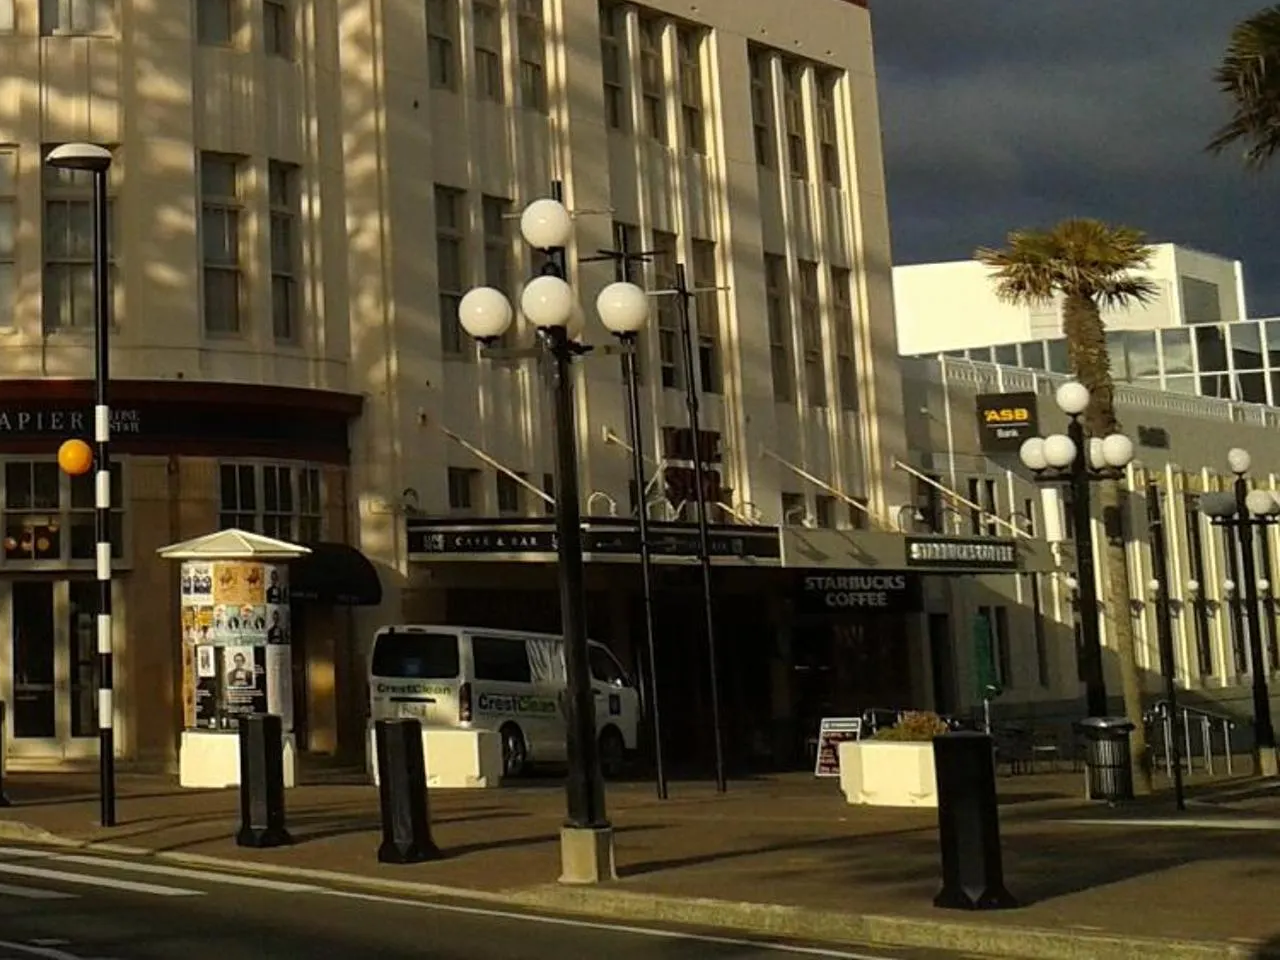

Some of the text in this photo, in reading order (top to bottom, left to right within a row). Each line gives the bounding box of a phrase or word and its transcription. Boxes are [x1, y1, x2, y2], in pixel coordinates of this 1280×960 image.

[984, 408, 1029, 422] ASB
[804, 575, 906, 591] STARBUCKS
[825, 591, 889, 607] COFFEE
[376, 682, 452, 695] CrestClean
[479, 693, 556, 711] CrestClean
